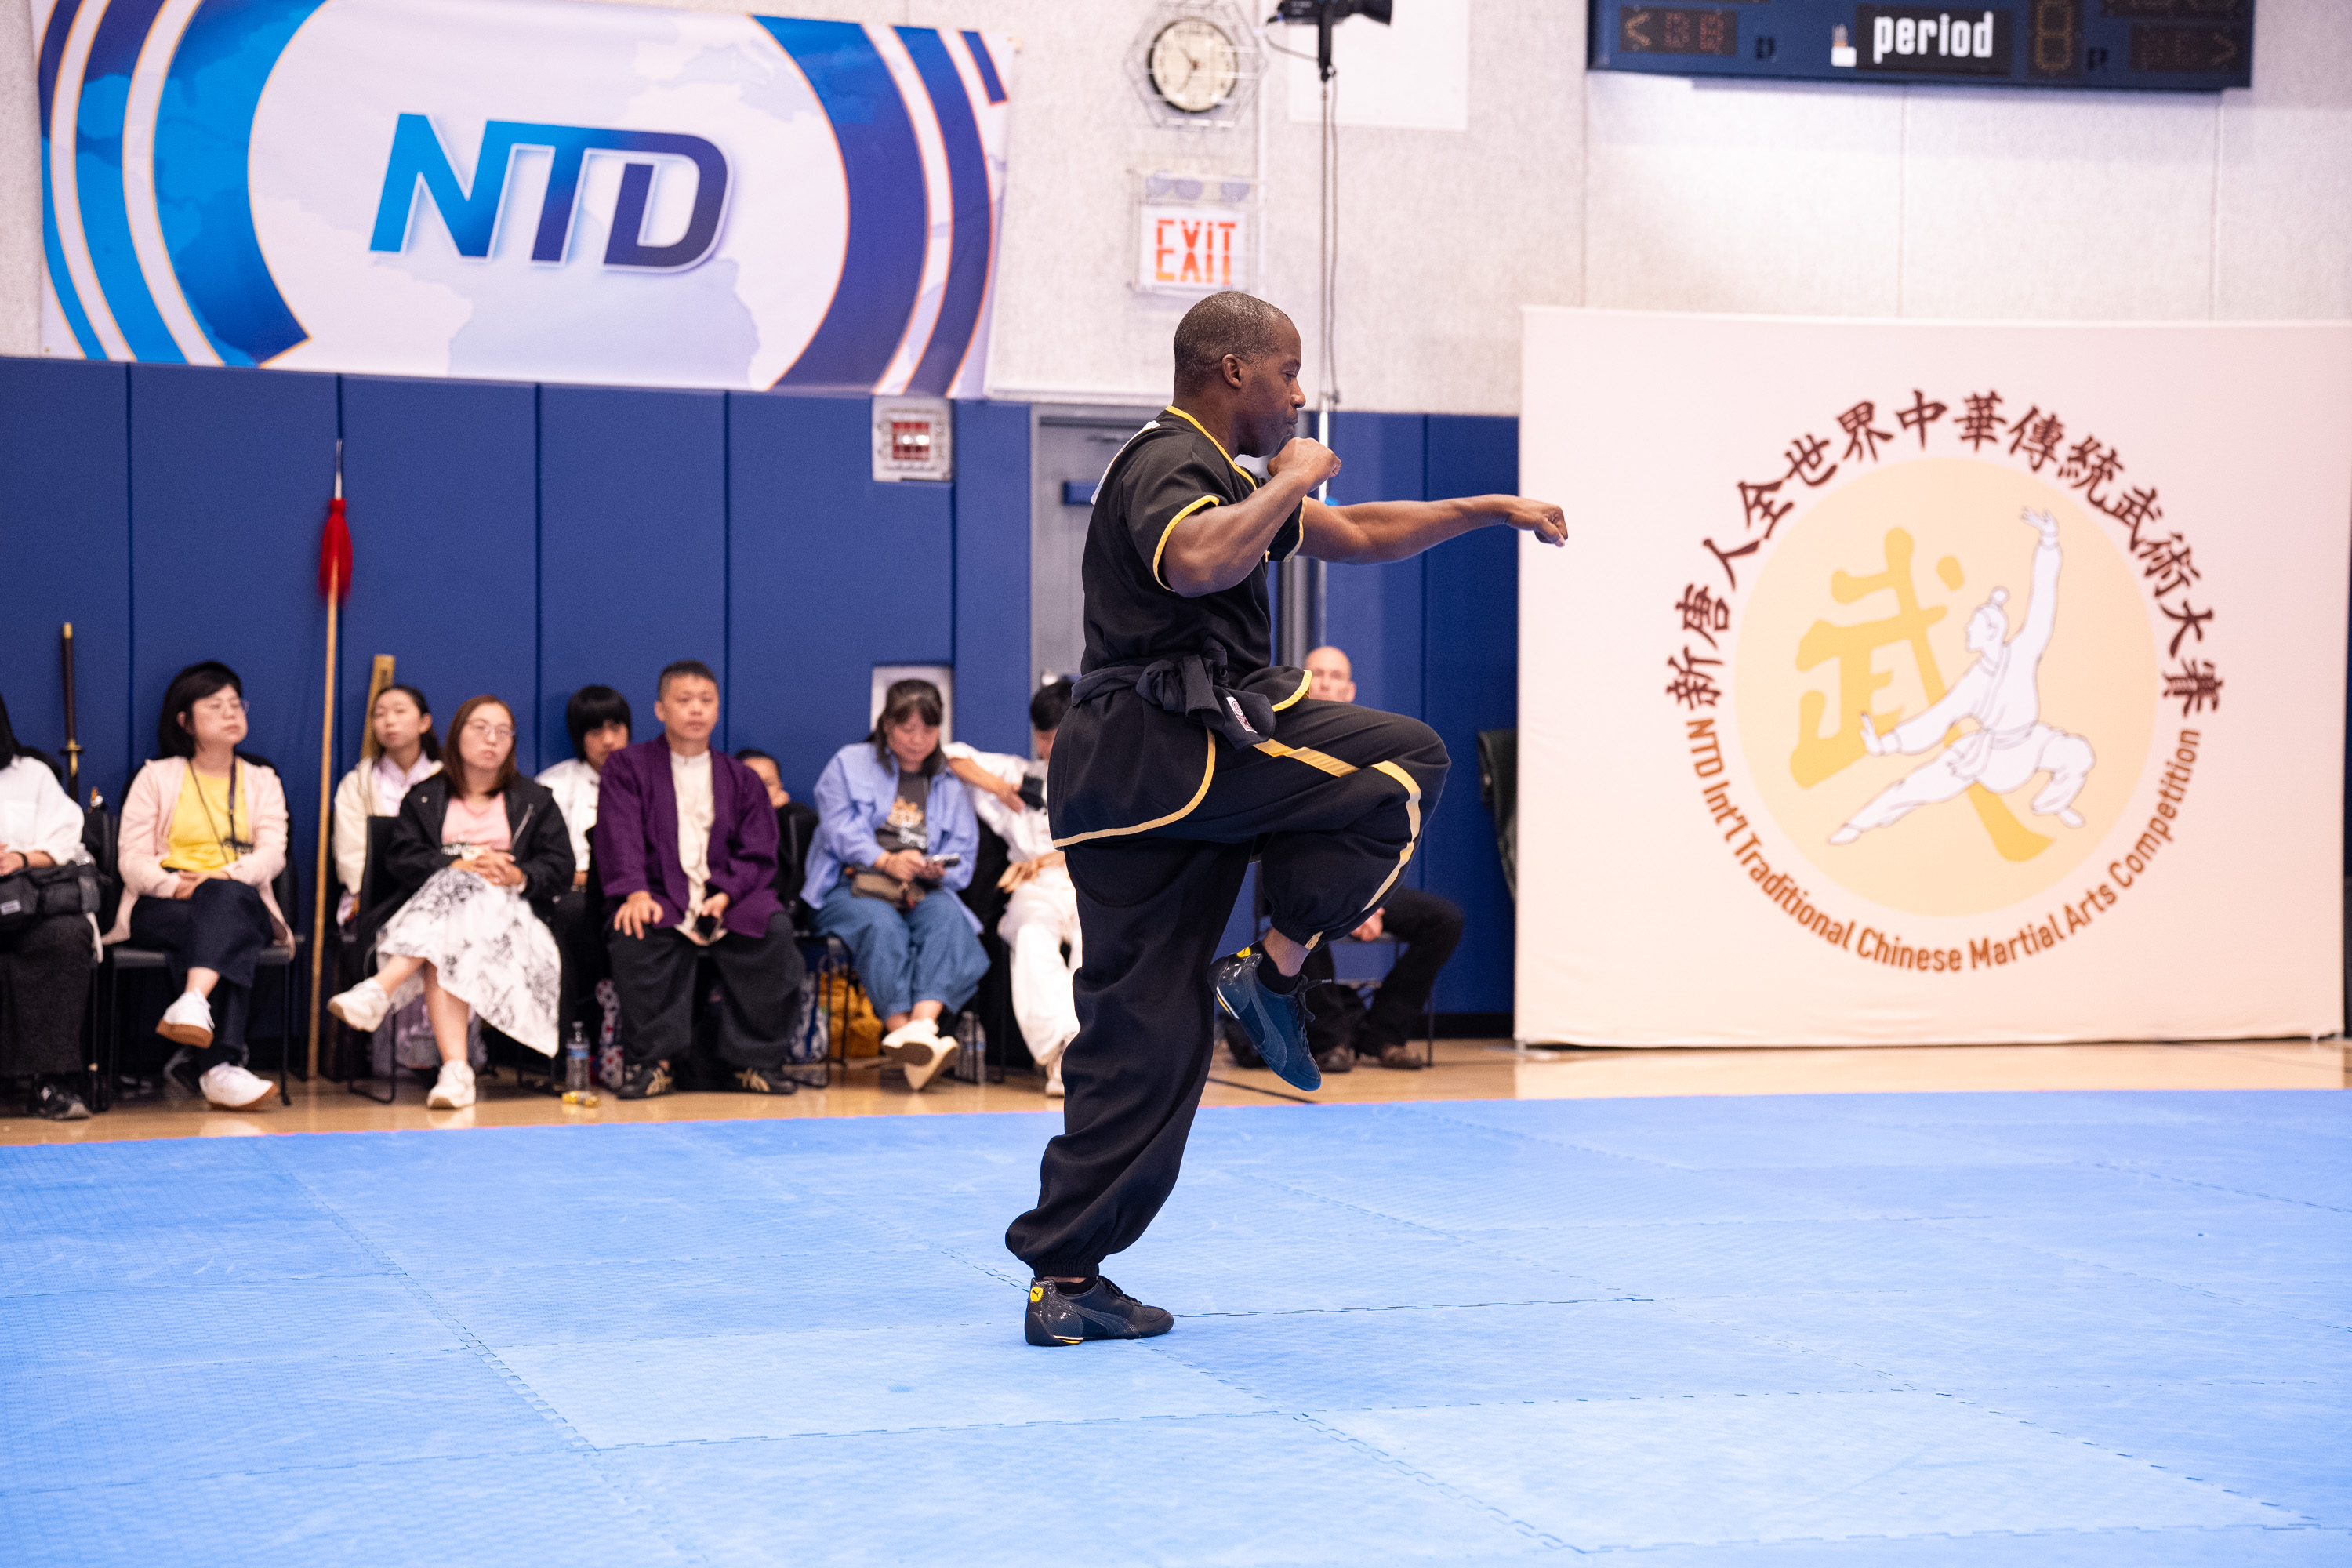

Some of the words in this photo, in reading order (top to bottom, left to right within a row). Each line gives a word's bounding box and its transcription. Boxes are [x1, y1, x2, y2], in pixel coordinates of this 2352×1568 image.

[1874, 11, 1994, 64] period
[369, 113, 729, 270] NTD
[1156, 219, 1236, 285] EXIT
[1666, 390, 2224, 717] 新唐人全世界中華傳統武術大賽
[1686, 717, 1725, 779] NTD
[1702, 780, 1749, 842] Int'l
[2107, 728, 2201, 888] Competition
[1733, 832, 1855, 950] Traditional
[2063, 883, 2118, 935] Arts
[1857, 927, 1962, 972] Chinese
[1969, 913, 2065, 971] Martial
